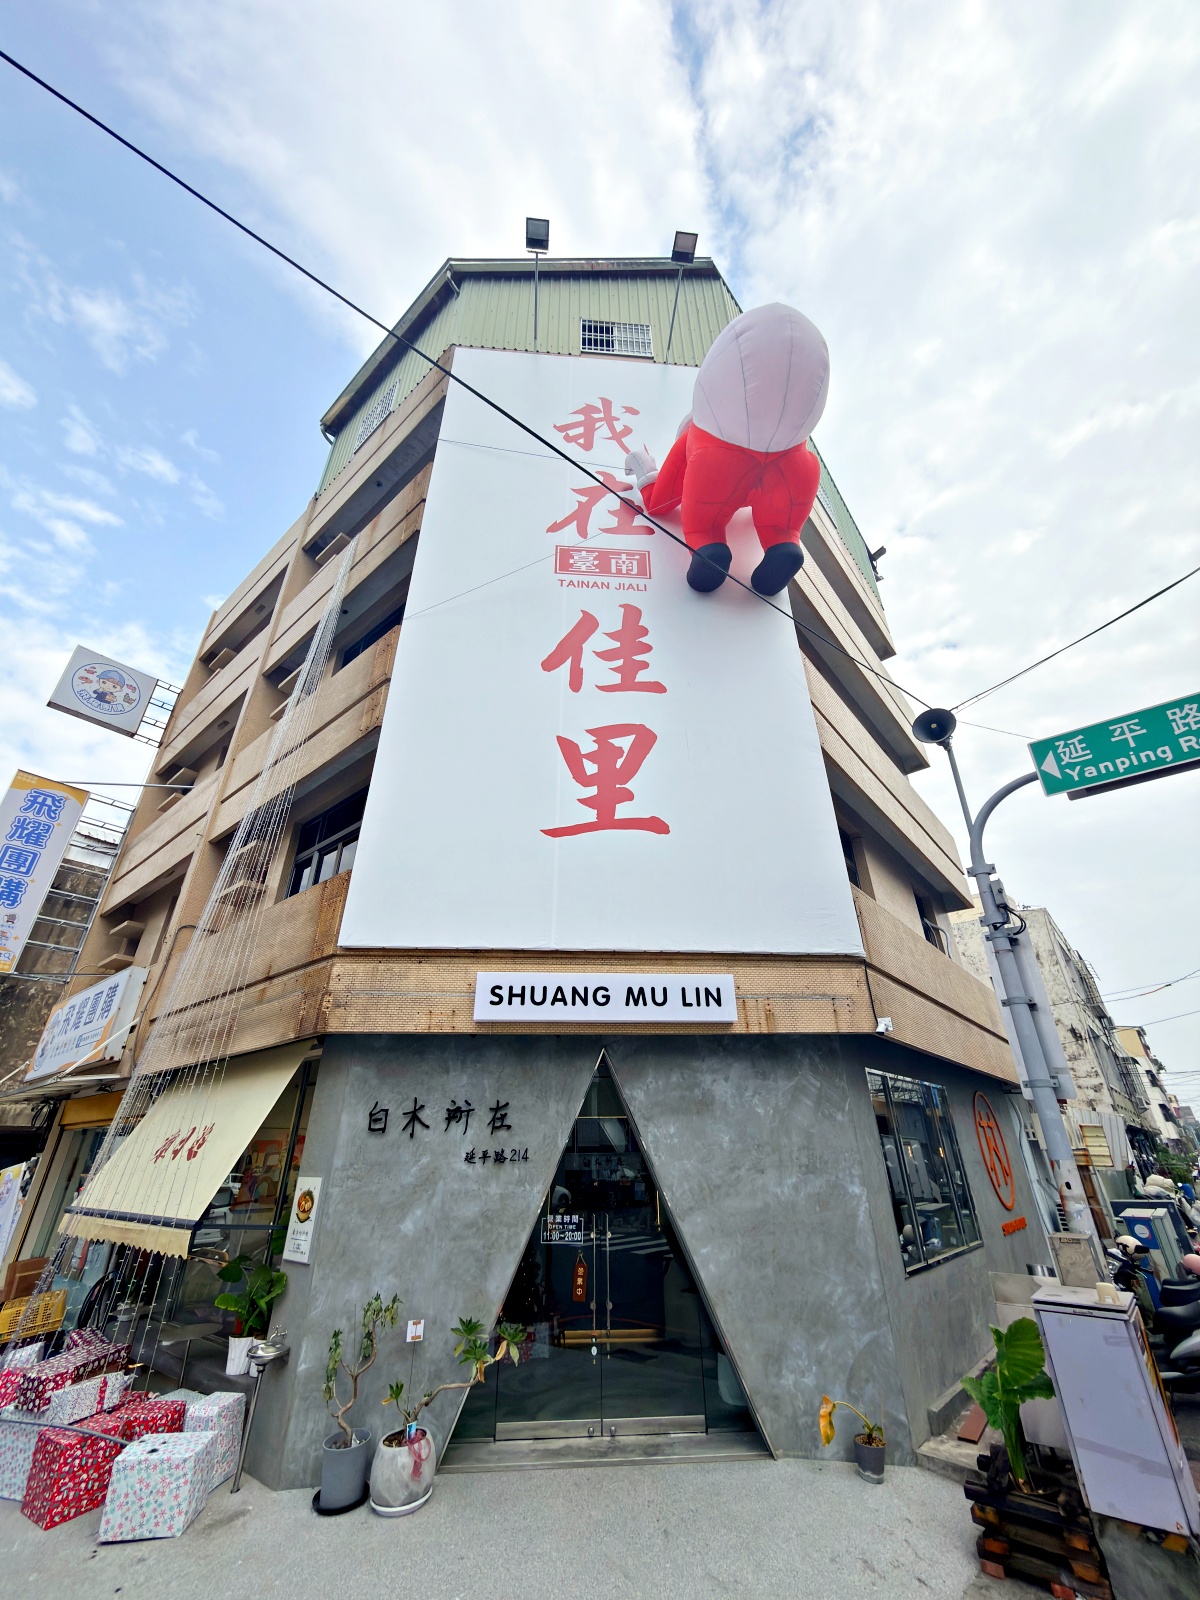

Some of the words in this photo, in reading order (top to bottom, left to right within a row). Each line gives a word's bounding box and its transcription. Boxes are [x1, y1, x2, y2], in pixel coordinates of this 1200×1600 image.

[569, 551, 640, 574] 臺南
[558, 579, 610, 590] TAINAN
[615, 583, 647, 592] JIALI
[540, 604, 670, 838] 佳里
[1055, 704, 1200, 765] 延平路
[1064, 745, 1173, 781] Yanping
[490, 985, 611, 1006] SHUANG
[625, 986, 668, 1007] MU
[681, 987, 722, 1007] LIN
[368, 1097, 512, 1138] 白木所在
